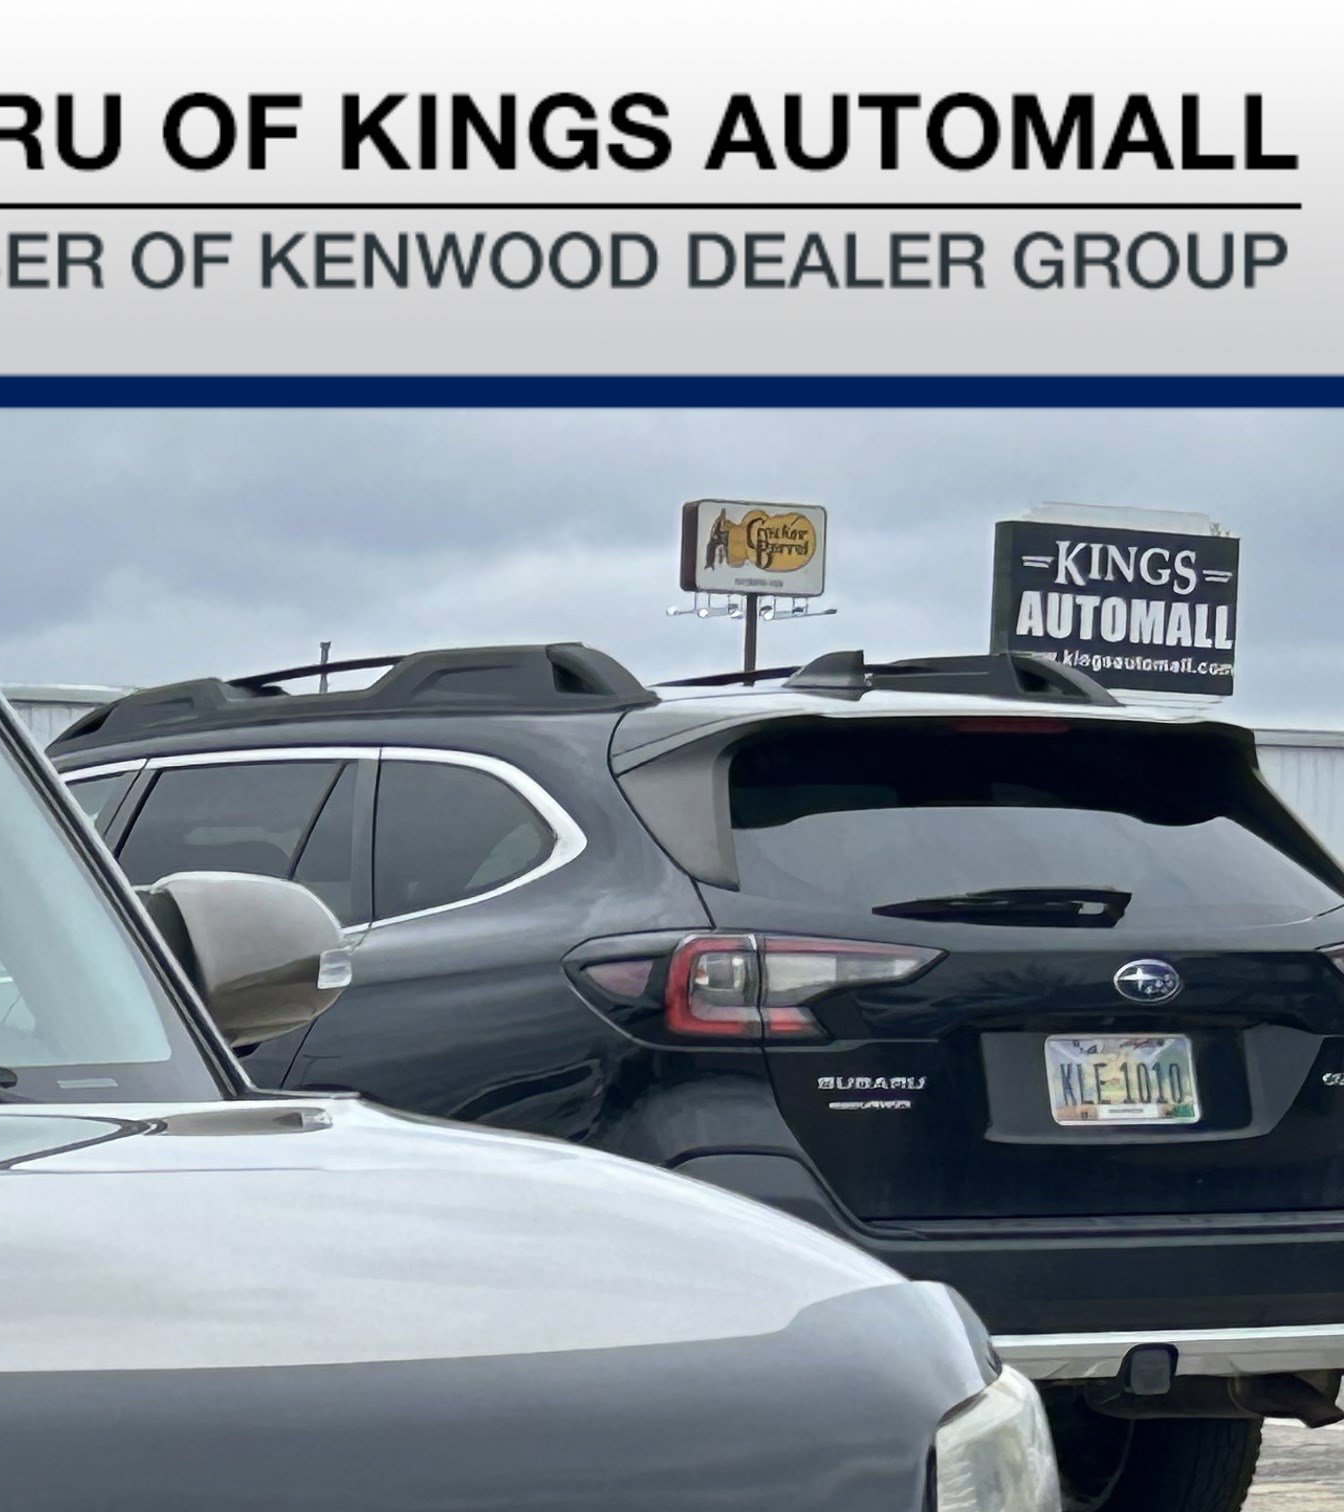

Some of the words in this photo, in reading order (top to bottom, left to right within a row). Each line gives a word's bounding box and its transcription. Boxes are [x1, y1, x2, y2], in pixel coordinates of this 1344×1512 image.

[1054, 540, 1197, 595] KINGS
[1015, 590, 1234, 650] AUTOMALL
[817, 1076, 927, 1090] SUBARU
[1060, 1062, 1112, 1106] KLE
[1119, 1061, 1184, 1105] 1010
